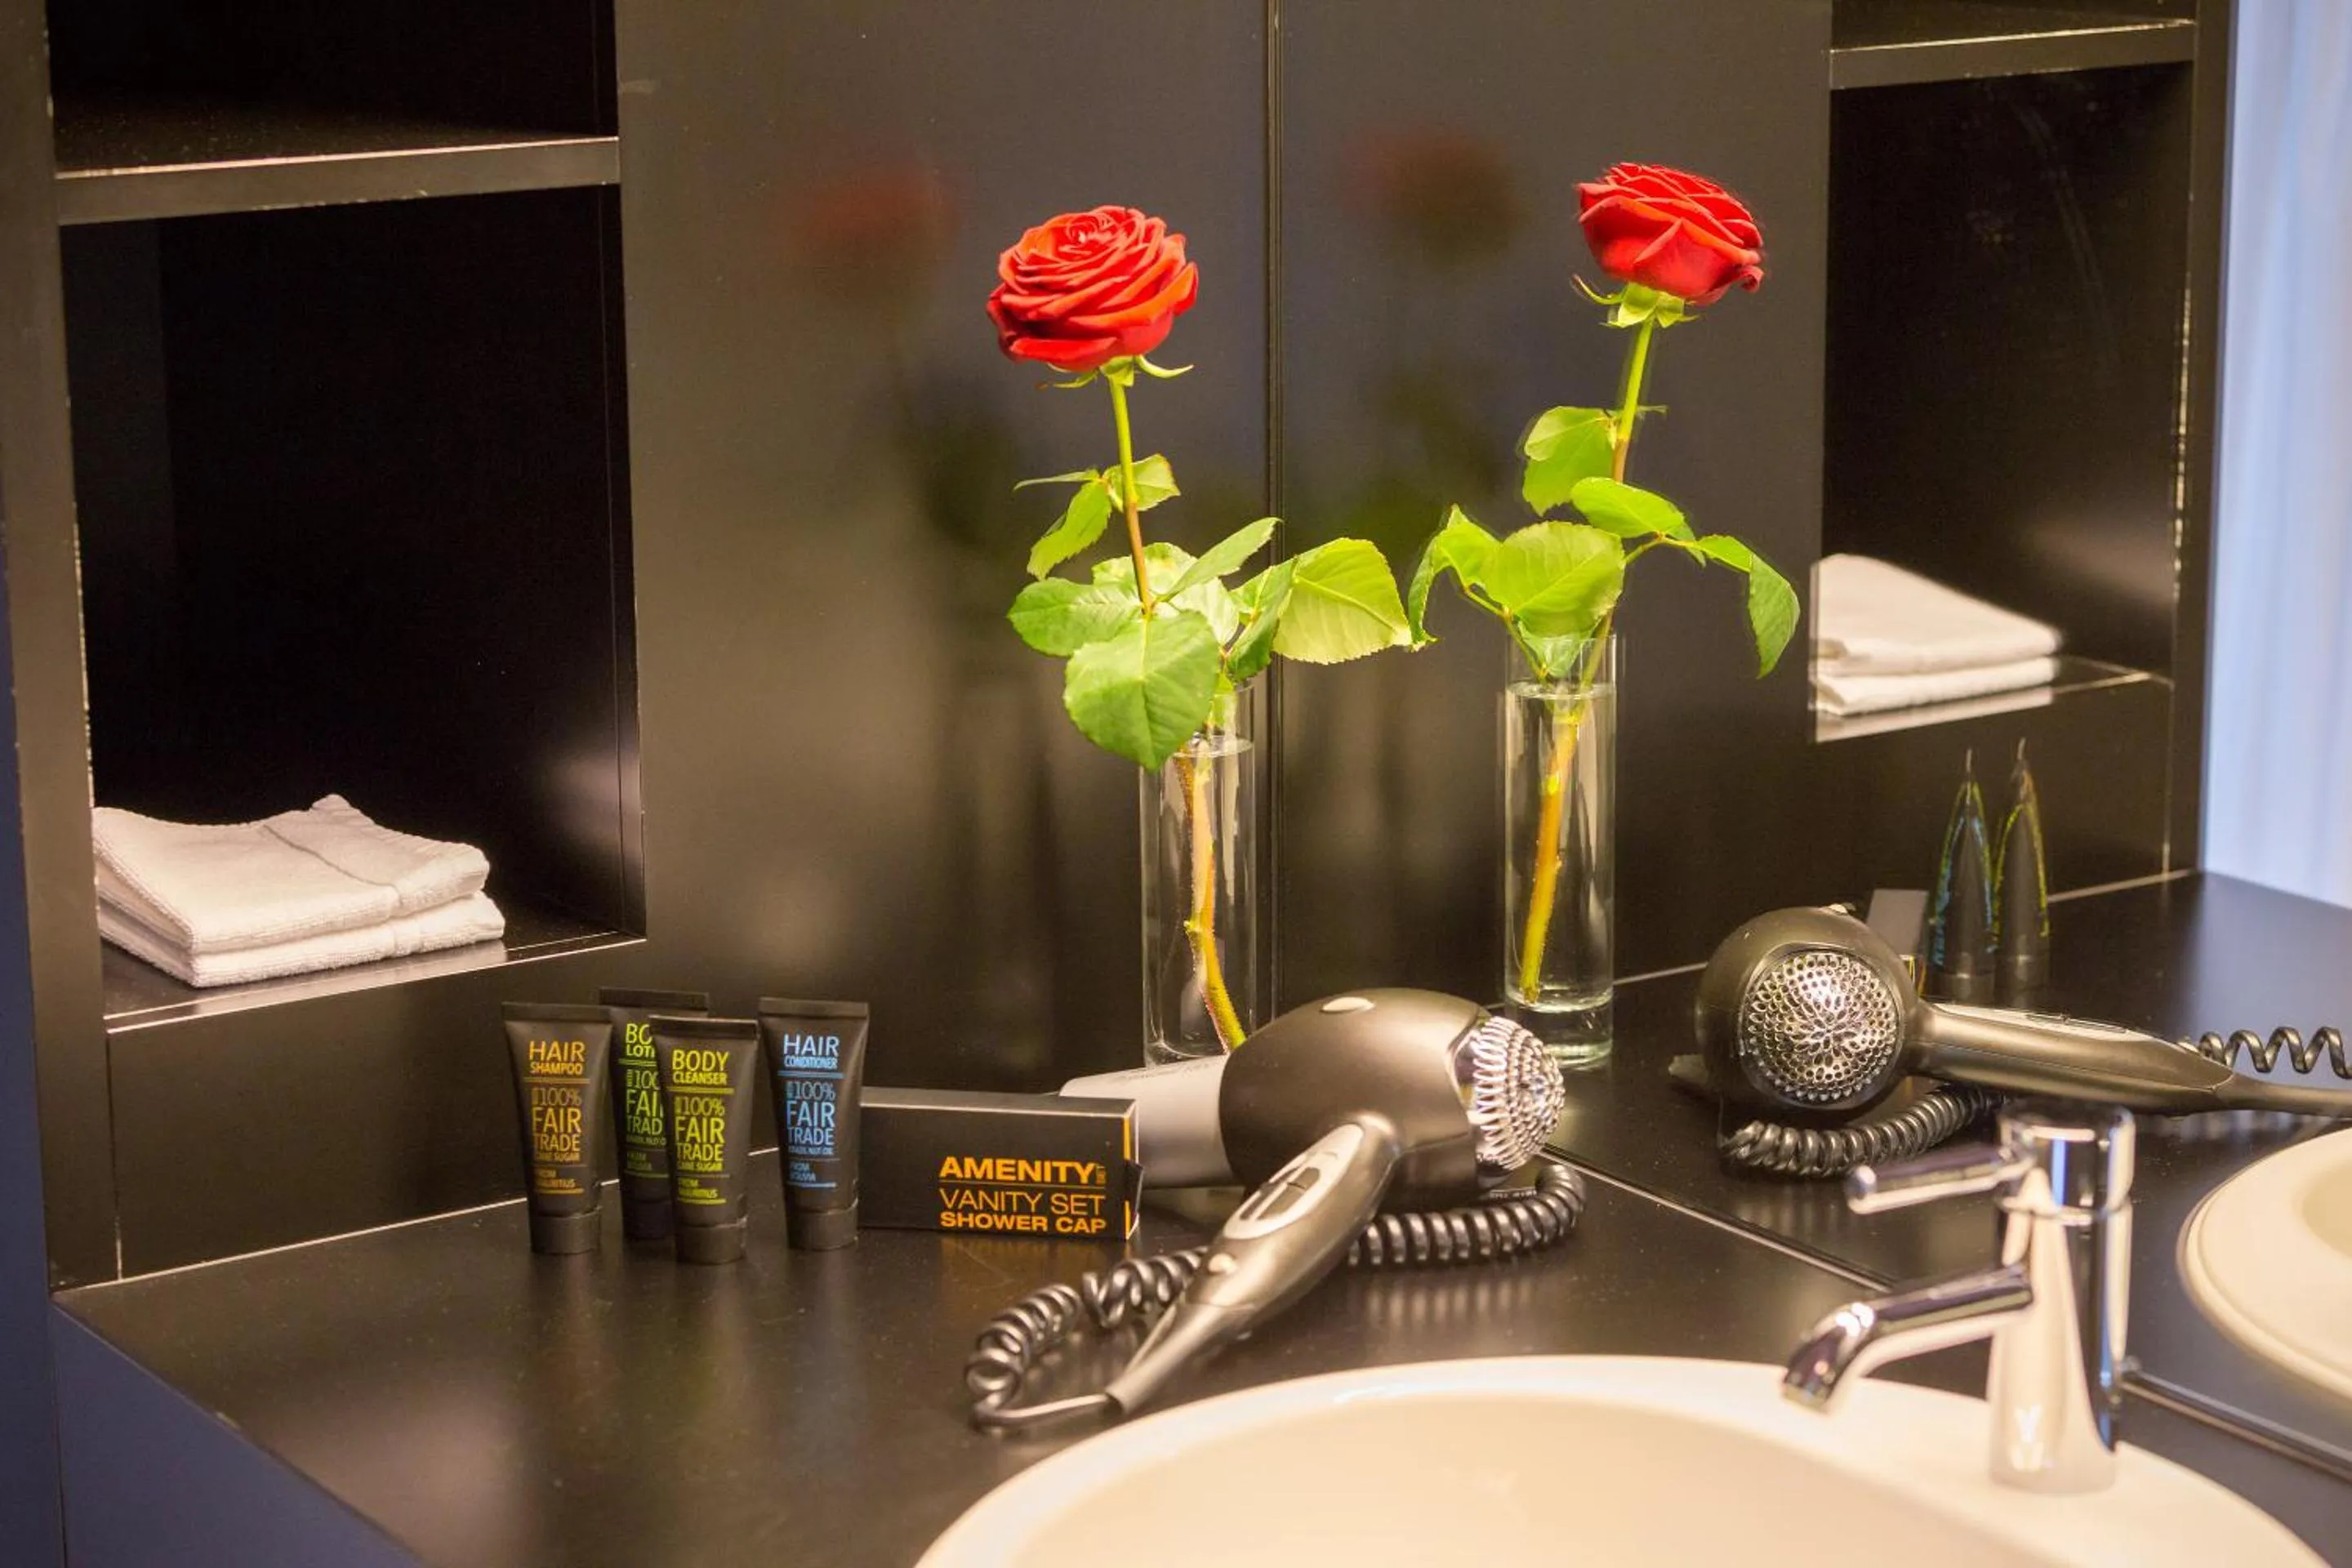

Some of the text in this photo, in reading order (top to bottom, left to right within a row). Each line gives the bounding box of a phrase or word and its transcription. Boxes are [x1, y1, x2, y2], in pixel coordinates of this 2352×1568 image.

[626, 1023, 653, 1045] BO
[783, 1033, 840, 1057] HAIR
[529, 1040, 586, 1062] HAIR
[626, 1044, 656, 1058] LOTI
[672, 1049, 729, 1072] BODY
[531, 1062, 583, 1076] SHAMPOO
[784, 1055, 839, 1070] CONDITIONER
[672, 1071, 728, 1086] CLEANSER
[541, 1087, 582, 1107] 100%
[794, 1080, 836, 1102] 100%
[626, 1088, 663, 1119] FAI
[684, 1096, 725, 1116] 100%
[786, 1100, 836, 1129] FAIR
[532, 1107, 582, 1134] FAIR
[627, 1116, 663, 1136] TRAD
[675, 1116, 725, 1145] FAIR
[534, 1132, 581, 1152] TRADE
[788, 1126, 835, 1146] TRADE
[676, 1142, 724, 1162] TRADE
[939, 1156, 1097, 1185] AMENITY
[939, 1187, 1107, 1216] VANITY SET
[939, 1211, 1107, 1234] SHOWER CAP
